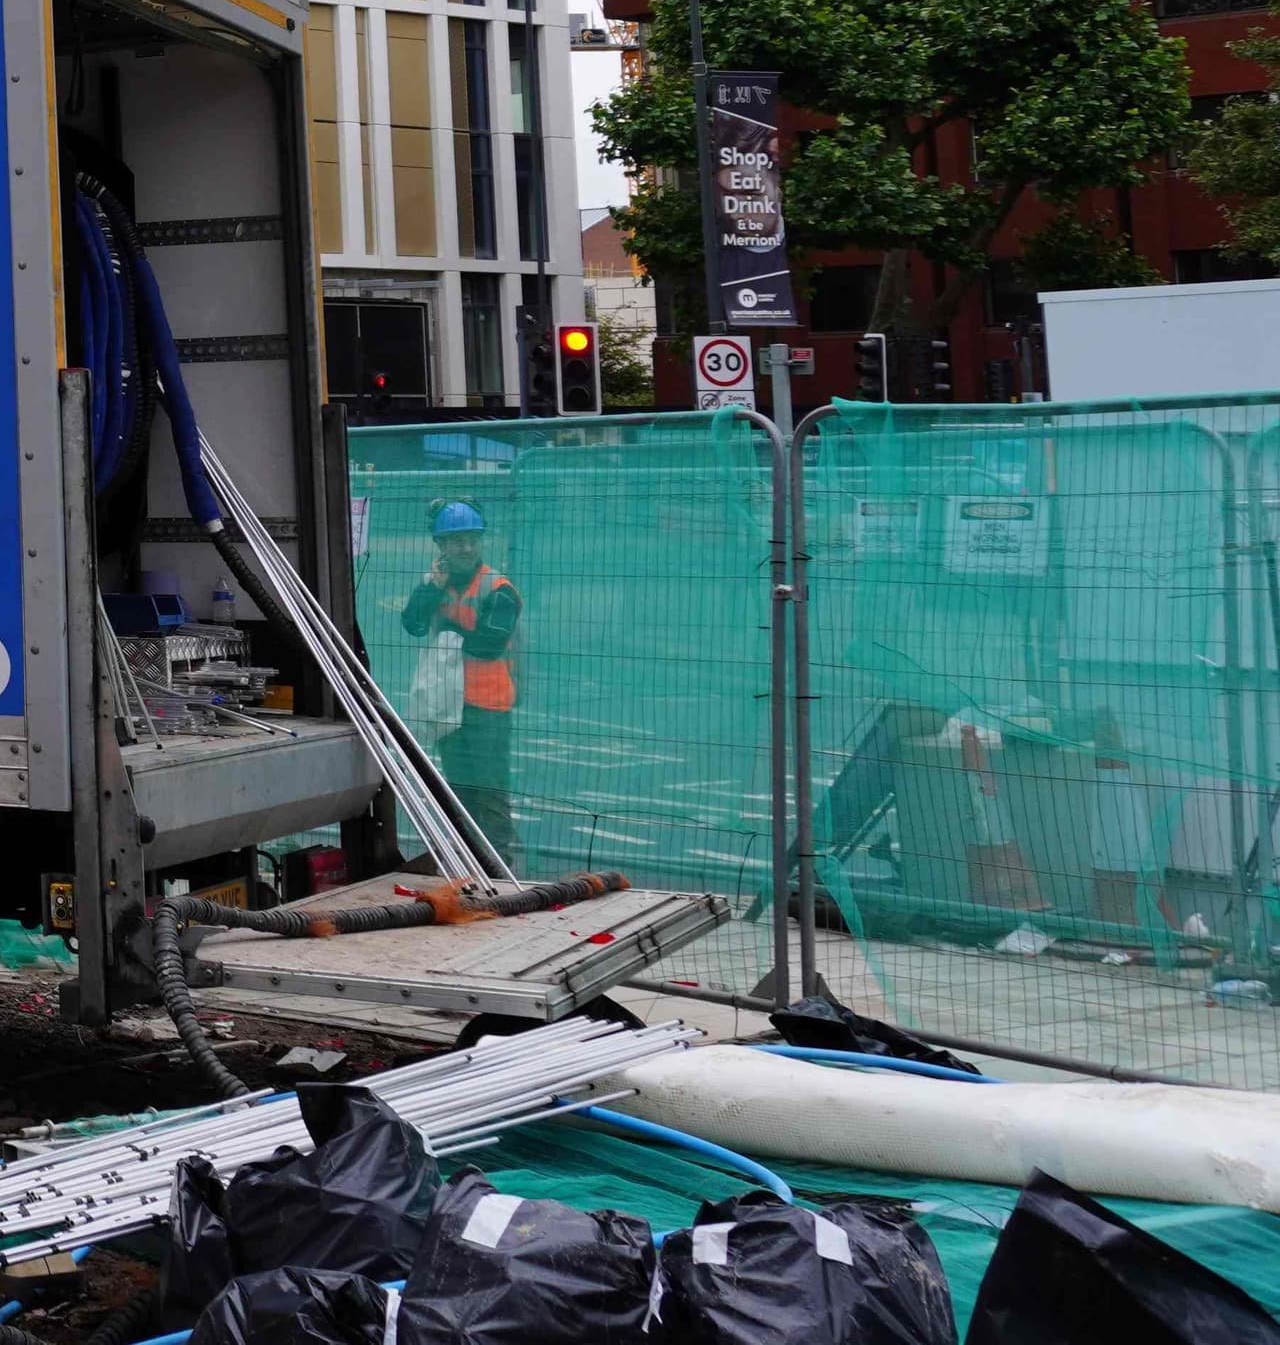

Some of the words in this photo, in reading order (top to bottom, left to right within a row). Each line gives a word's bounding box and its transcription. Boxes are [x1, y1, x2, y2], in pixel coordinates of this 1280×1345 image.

[720, 147, 774, 170] Shop,
[730, 171, 766, 194] Eat,
[724, 195, 776, 215] Drink
[738, 219, 747, 230] &
[749, 219, 763, 231] be
[723, 233, 781, 247] Merrion!
[707, 353, 741, 372] 30
